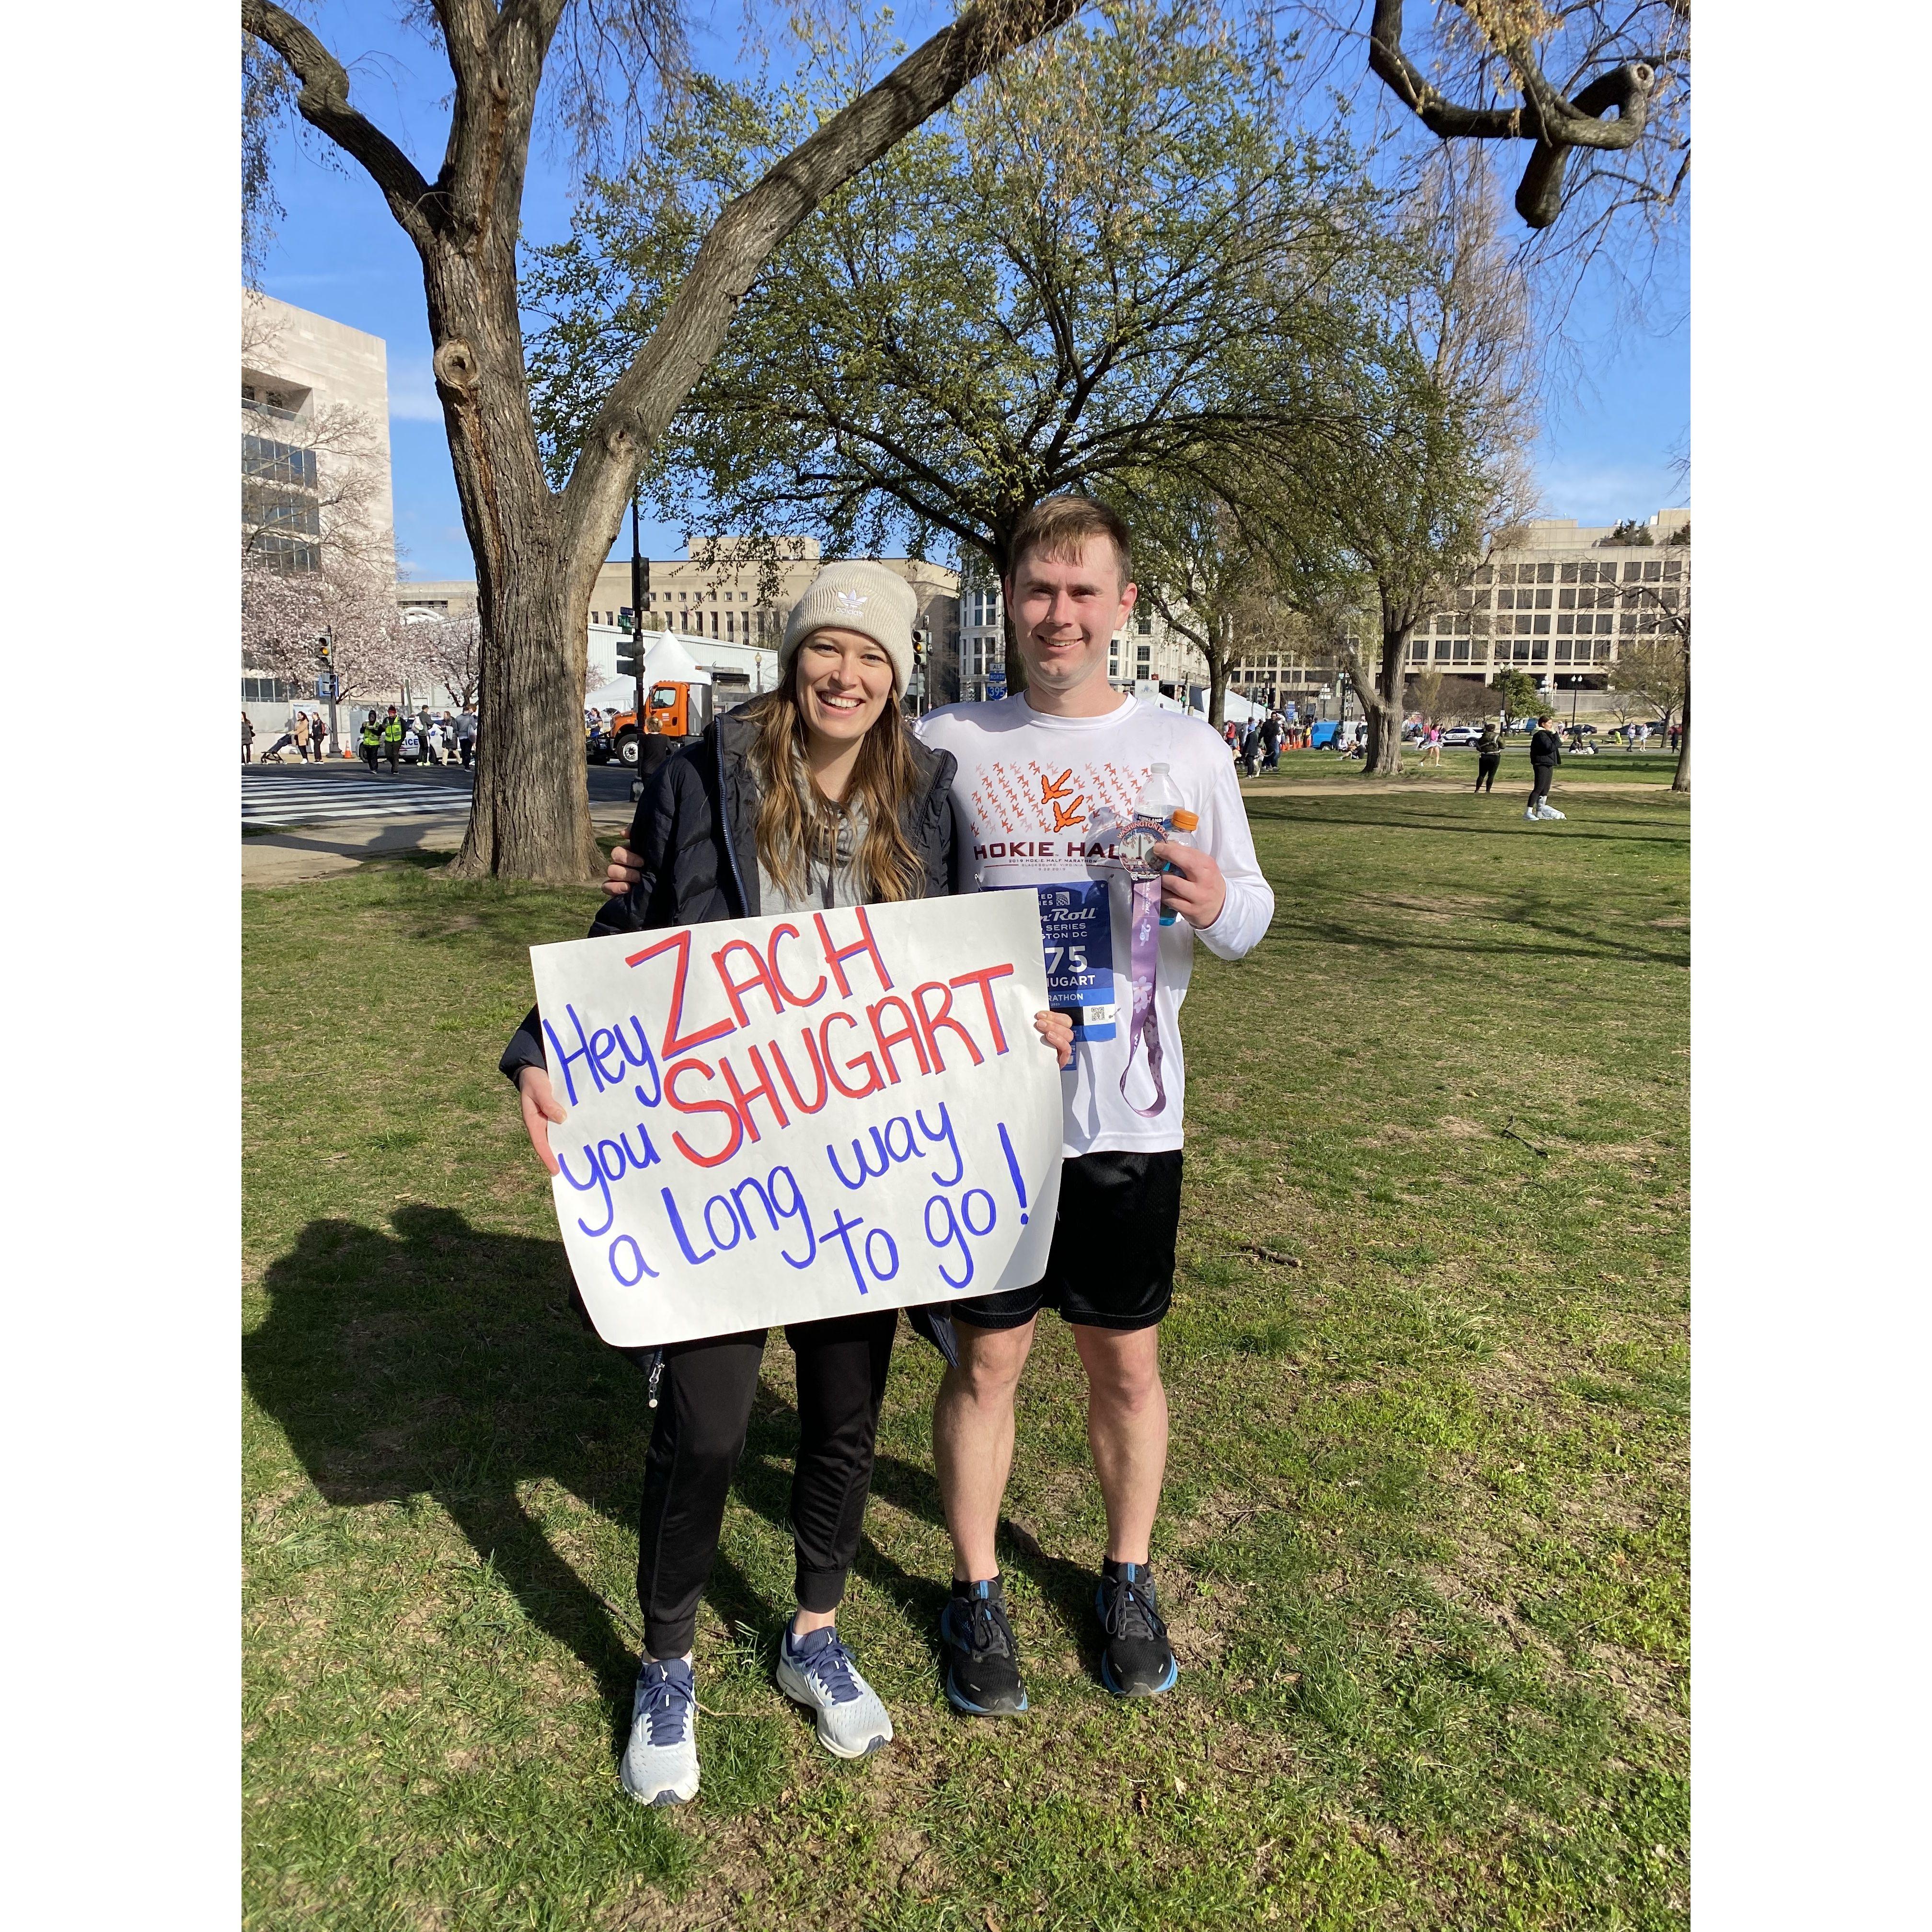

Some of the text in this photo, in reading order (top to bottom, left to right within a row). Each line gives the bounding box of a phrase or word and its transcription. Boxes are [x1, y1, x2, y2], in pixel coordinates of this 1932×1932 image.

[989, 687, 1005, 697] 395
[973, 841, 1119, 860] HOKIE HAL
[1045, 945, 1088, 974] 75
[1046, 923, 1086, 932] SERIES
[543, 907, 894, 1108] Hey ZACH
[663, 963, 1014, 1168] SHUGART
[558, 1123, 661, 1237] you
[610, 1234, 659, 1287] a
[827, 1102, 964, 1190] way
[819, 1208, 899, 1295] to
